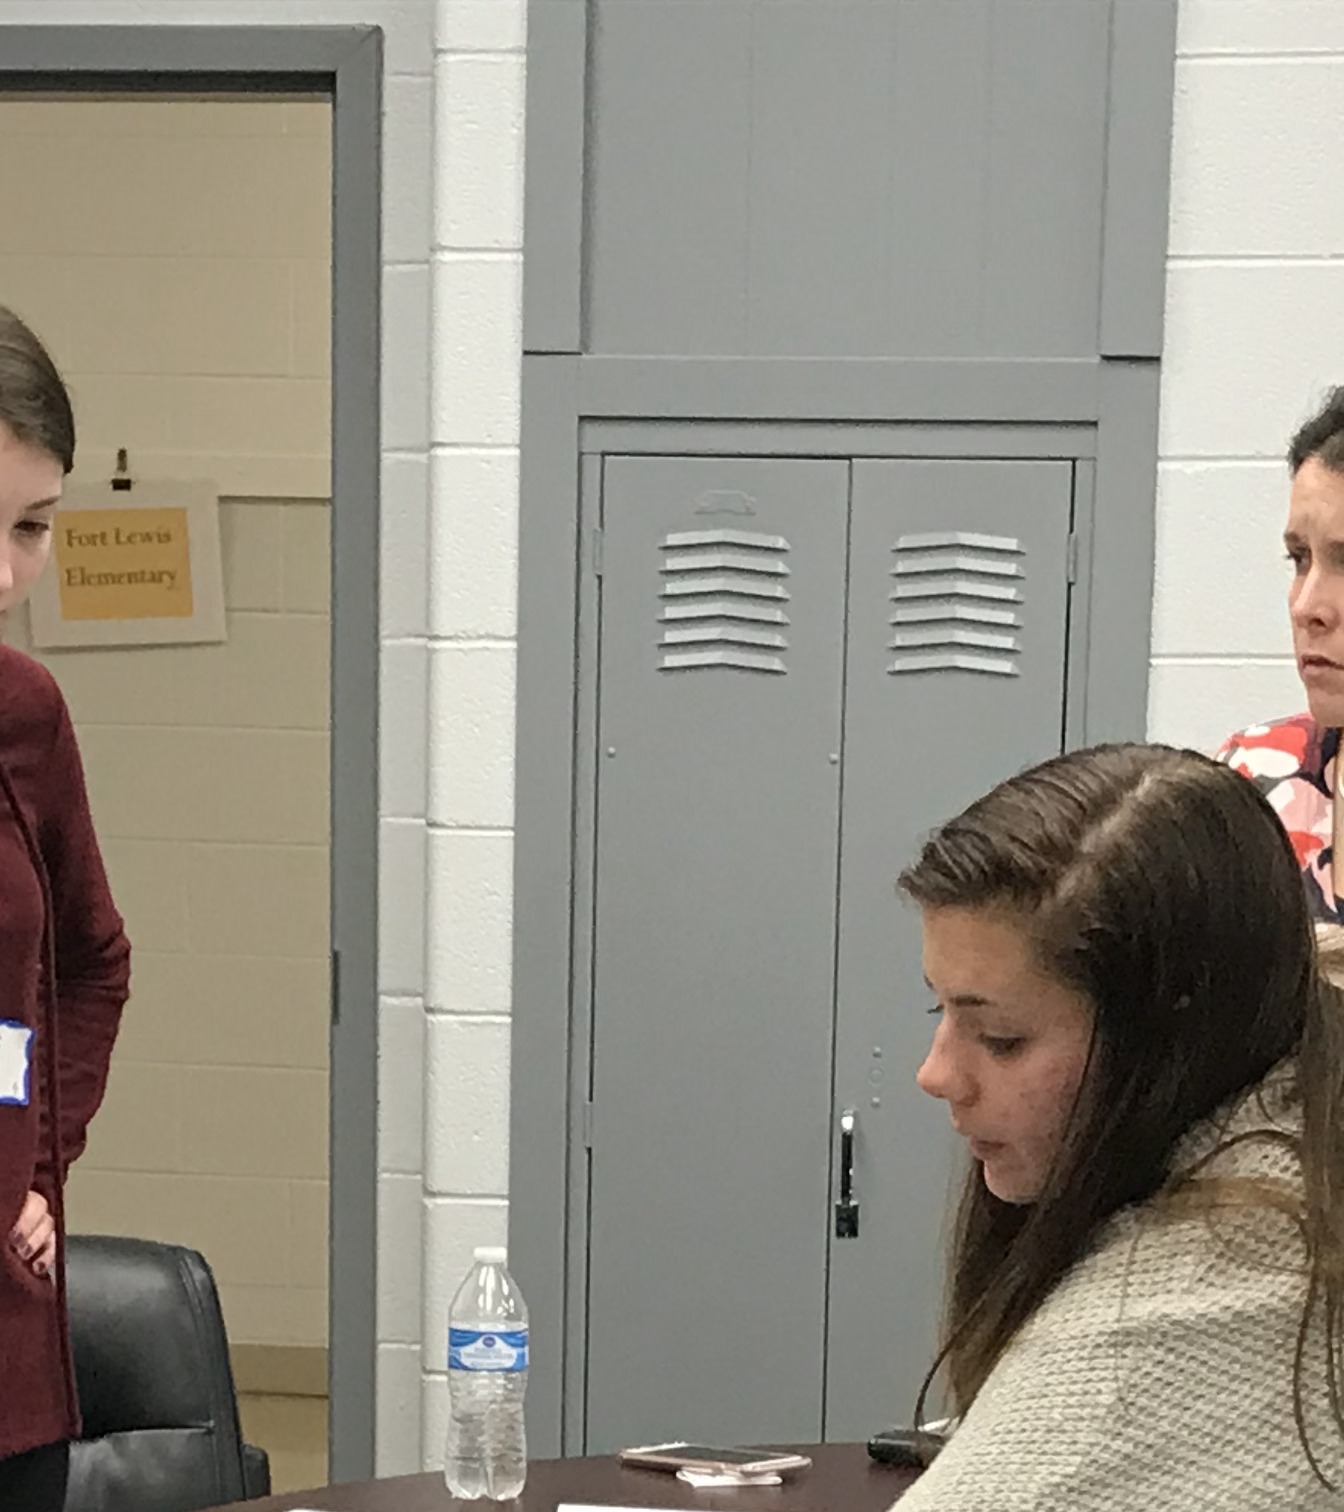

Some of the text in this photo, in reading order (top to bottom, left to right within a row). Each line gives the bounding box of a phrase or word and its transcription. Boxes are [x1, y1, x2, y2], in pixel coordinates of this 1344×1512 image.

[65, 527, 172, 548] Fort Lewis
[65, 567, 178, 590] Elementary
